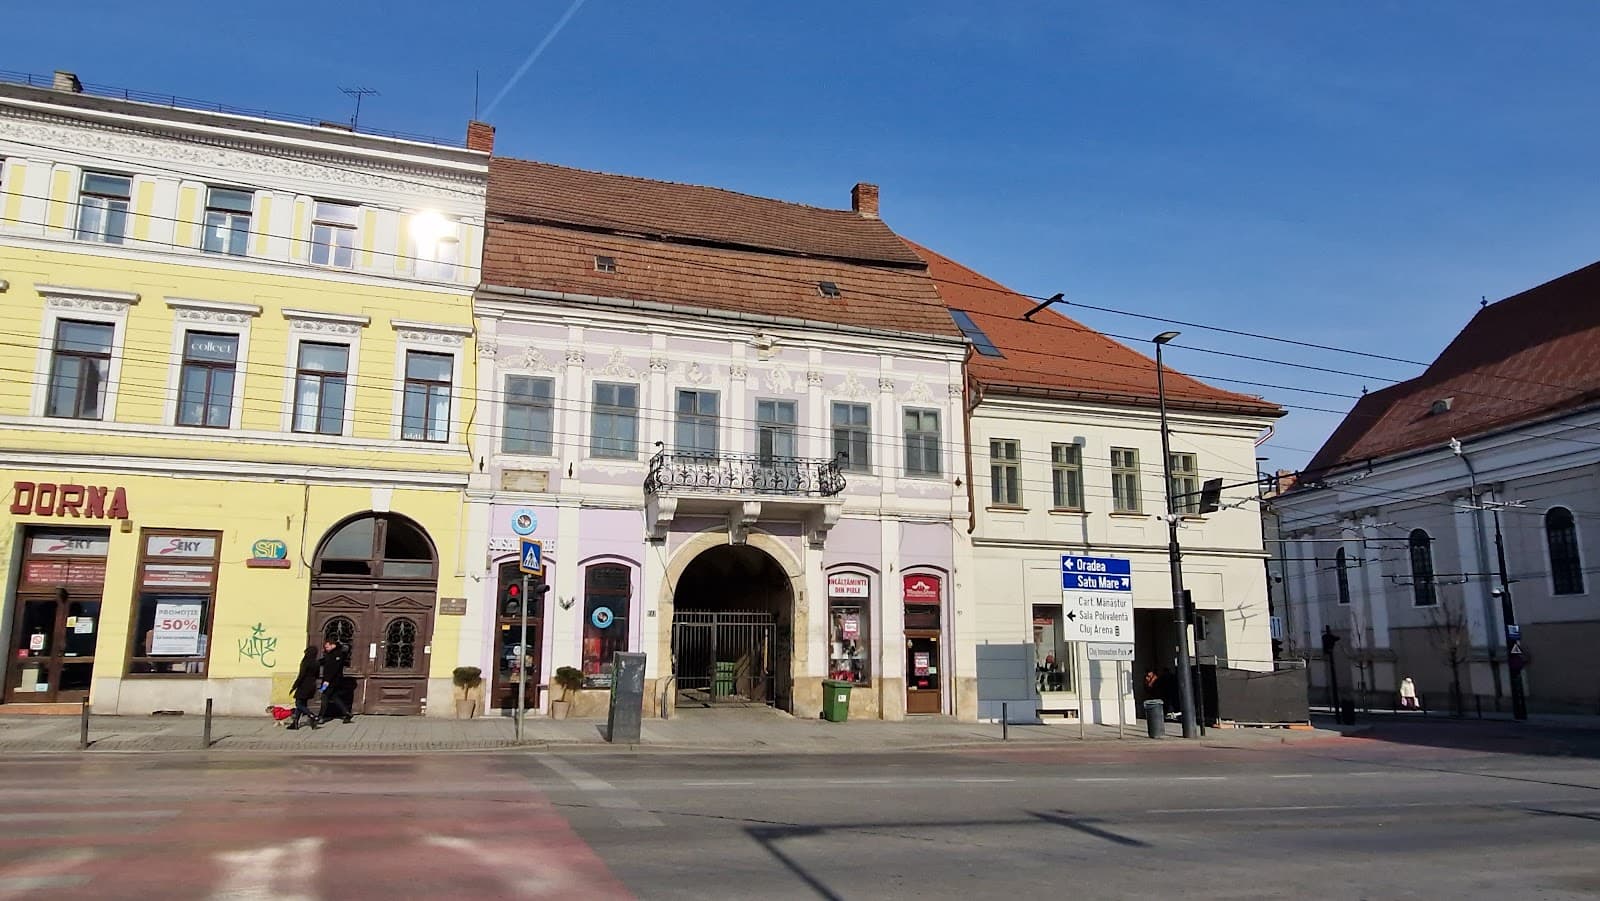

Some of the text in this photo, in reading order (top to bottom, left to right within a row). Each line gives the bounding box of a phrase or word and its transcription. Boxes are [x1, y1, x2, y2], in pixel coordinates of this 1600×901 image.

[191, 341, 232, 354] collect
[11, 481, 129, 520] DORNA
[47, 536, 93, 552] SEKY
[159, 538, 201, 555] SEKY
[1076, 558, 1107, 572] Oradea
[1077, 575, 1119, 589] Satu Mare
[1079, 610, 1093, 621] Sala
[155, 618, 197, 631] -50%
[1079, 624, 1114, 635] Cluj Arena
